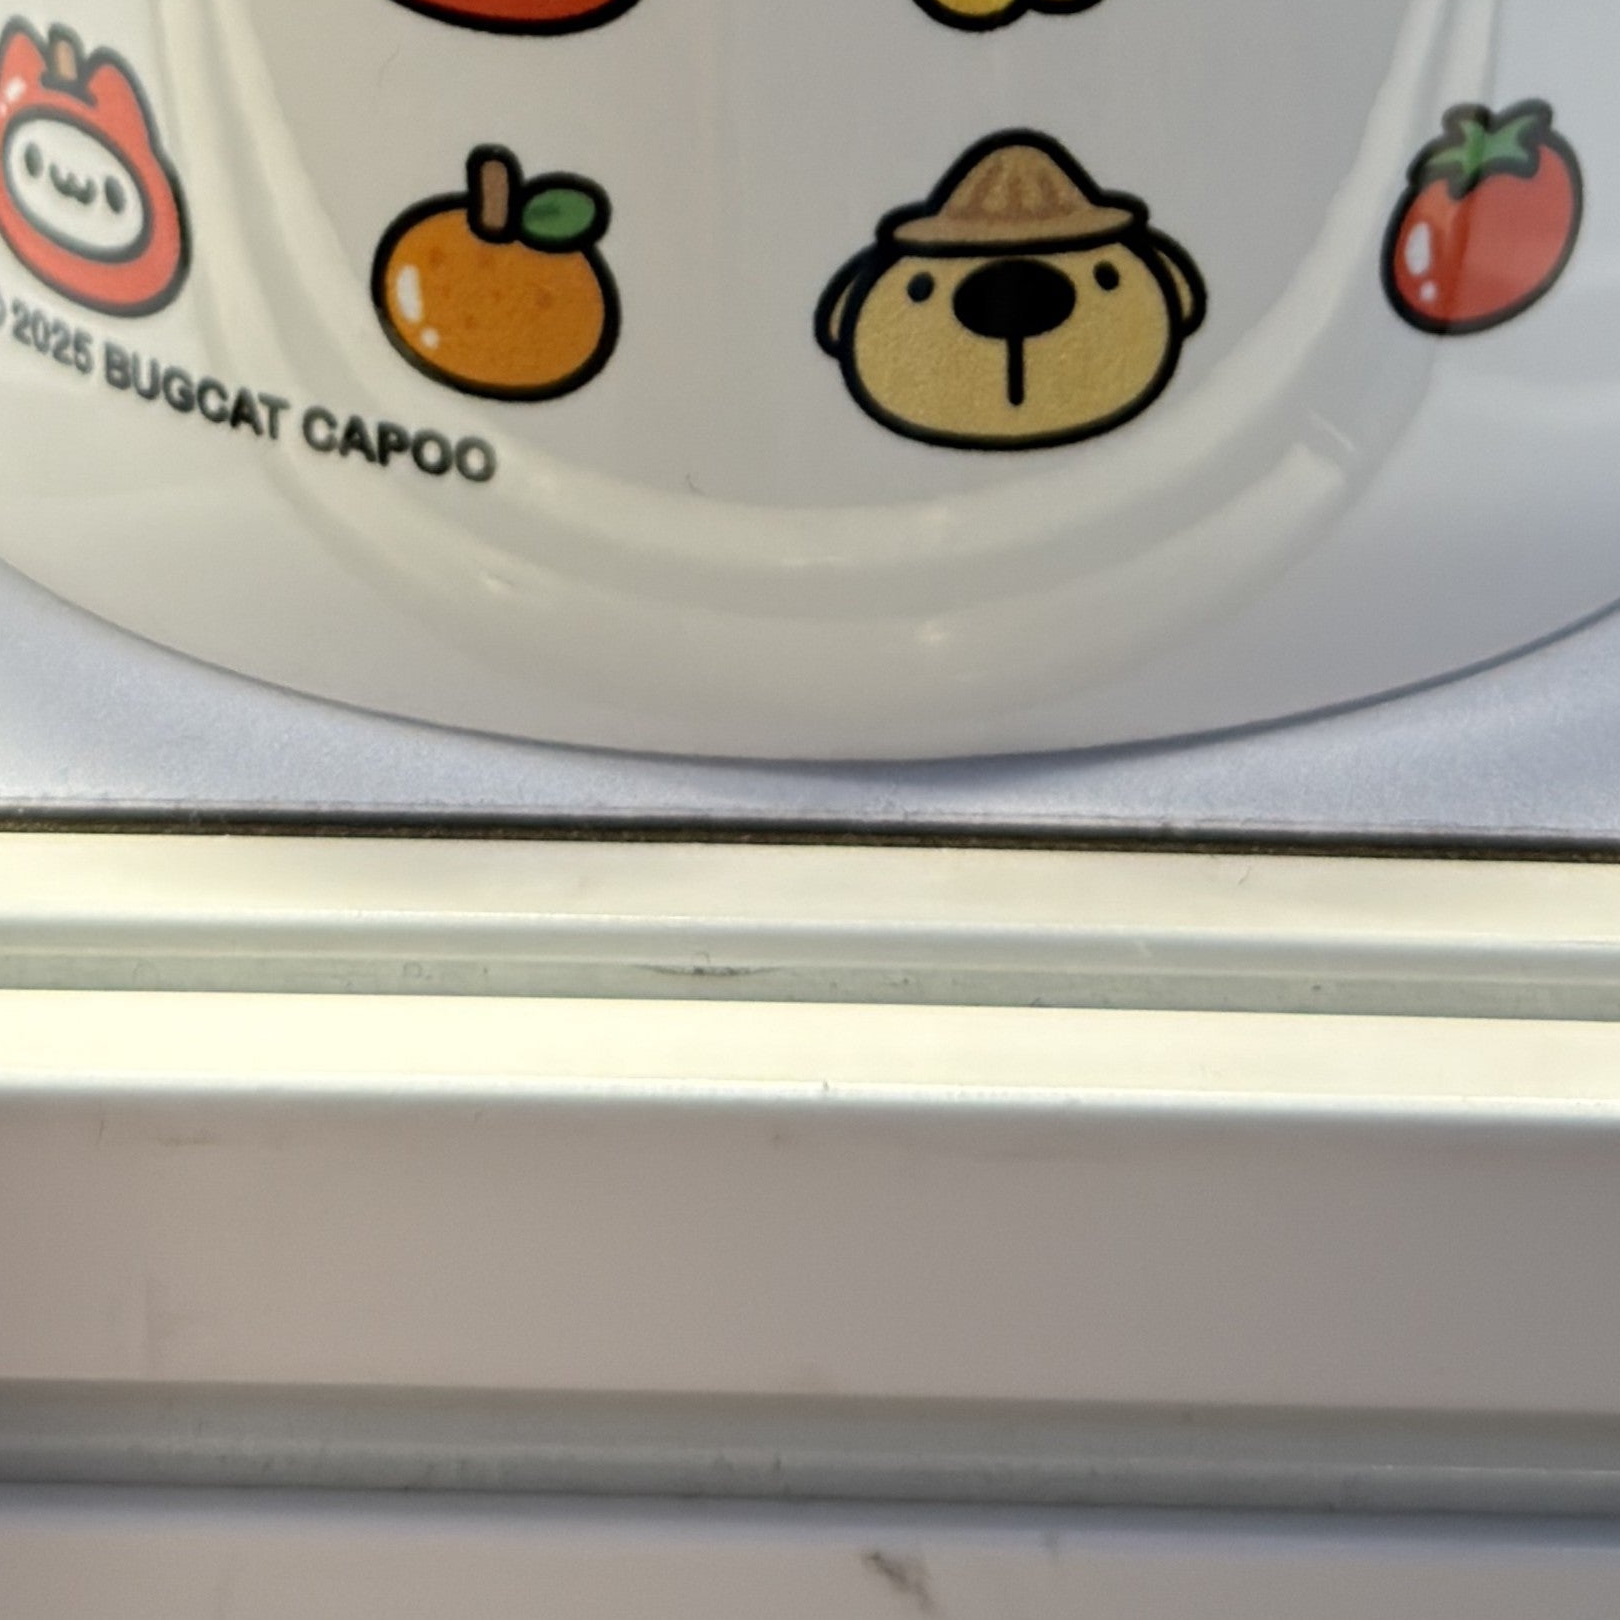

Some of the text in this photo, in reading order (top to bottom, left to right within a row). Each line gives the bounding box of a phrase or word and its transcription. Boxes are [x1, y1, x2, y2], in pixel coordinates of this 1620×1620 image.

[12, 298, 94, 375] 2025
[104, 341, 290, 441] BUGCAT
[302, 405, 498, 482] CAPOO
